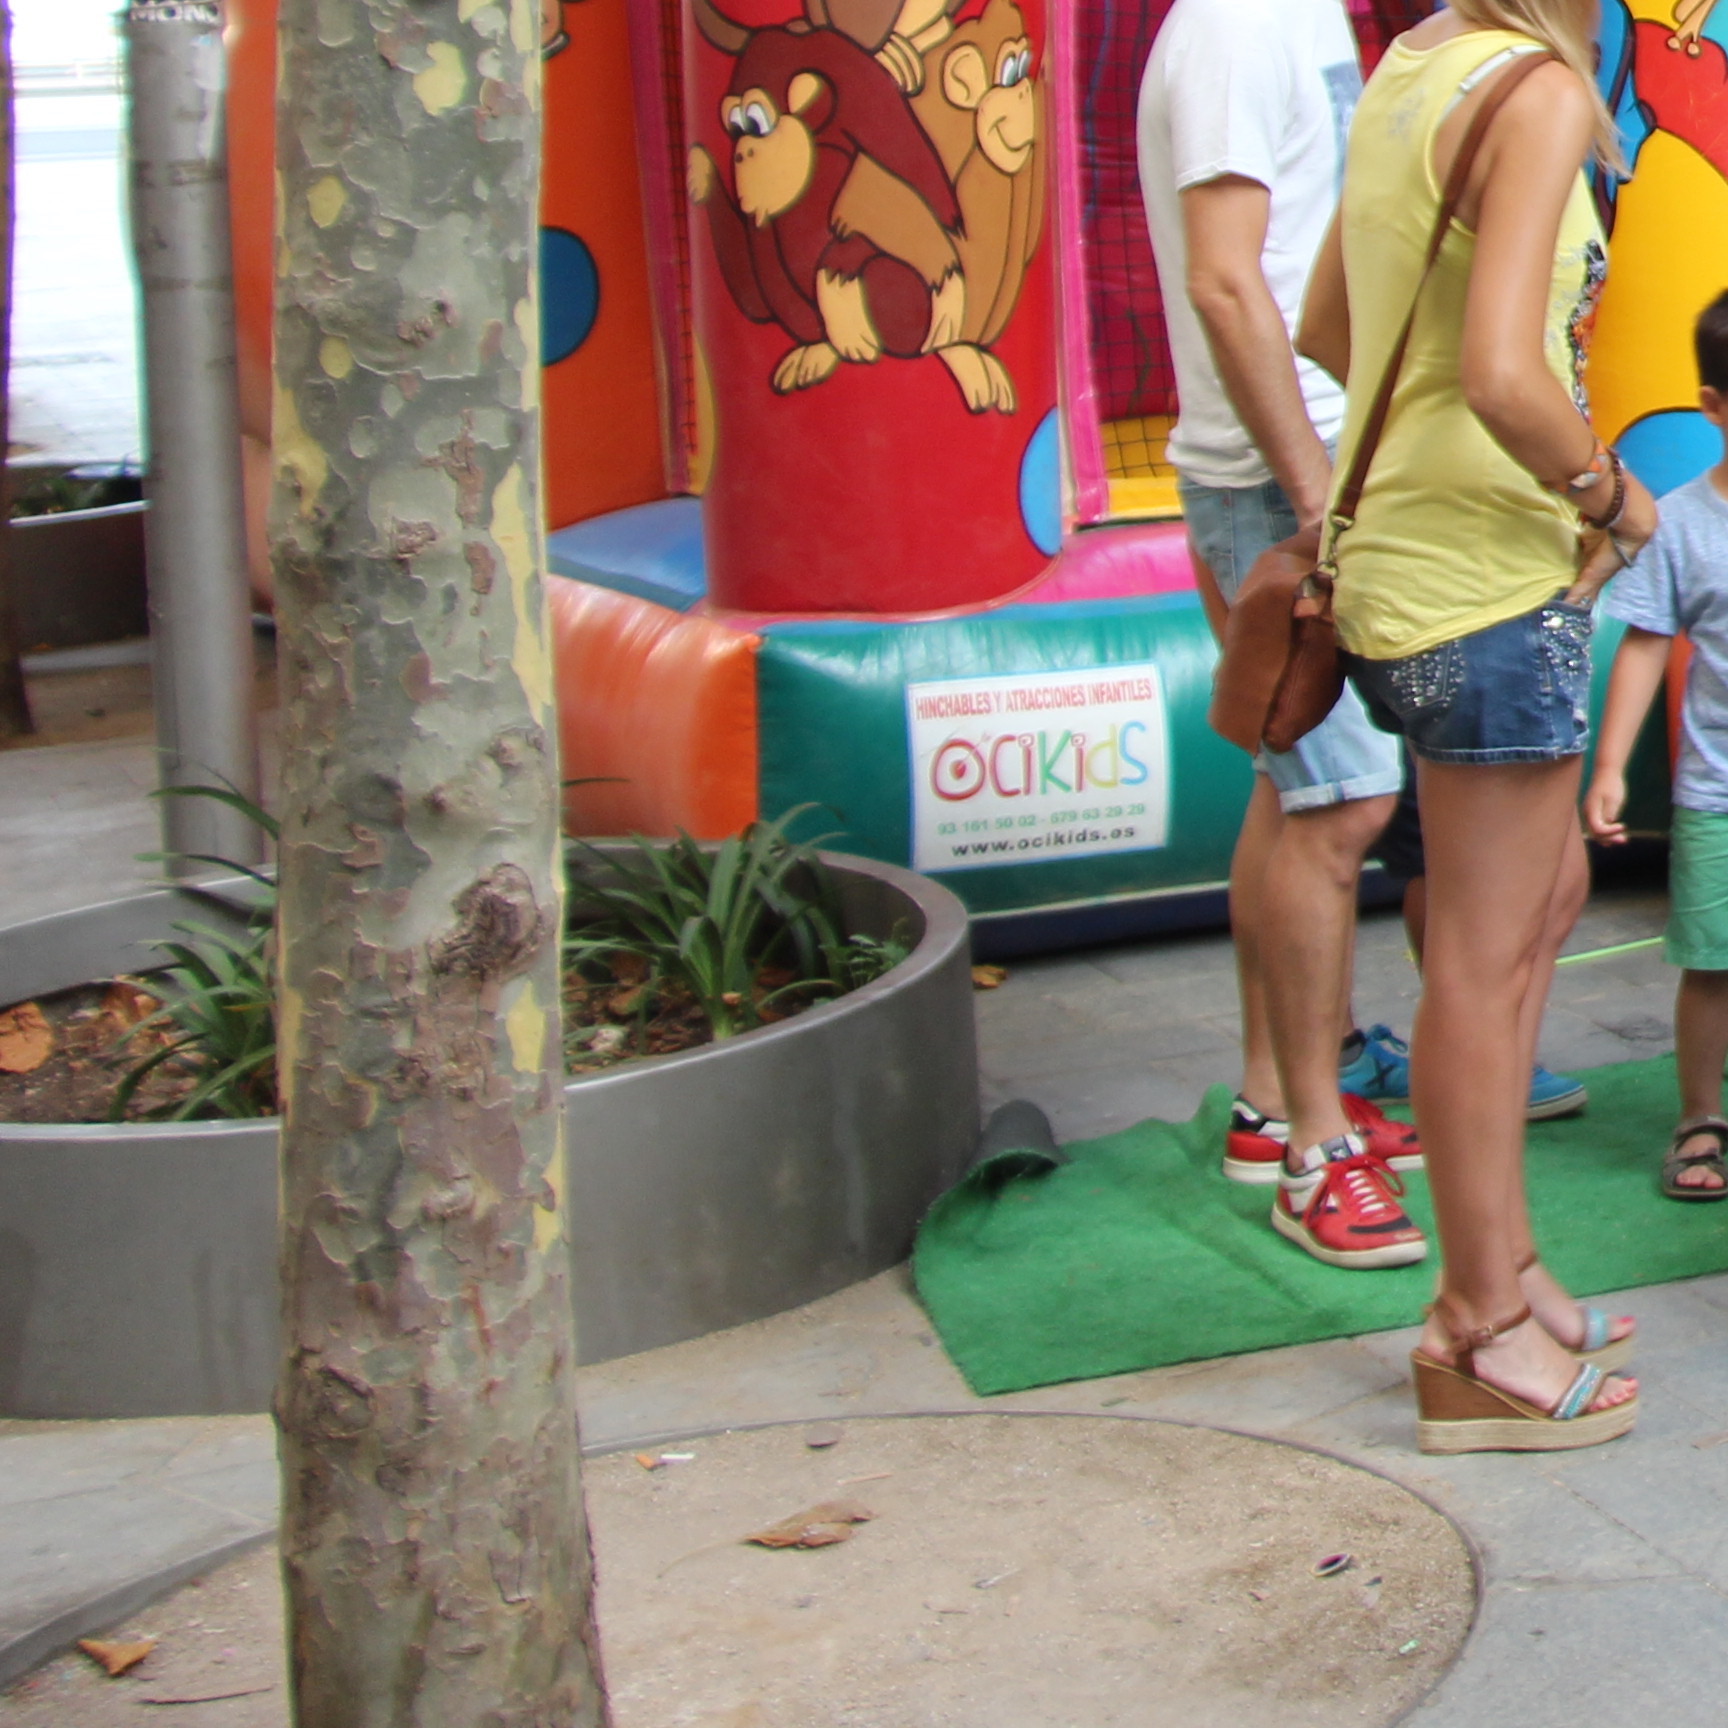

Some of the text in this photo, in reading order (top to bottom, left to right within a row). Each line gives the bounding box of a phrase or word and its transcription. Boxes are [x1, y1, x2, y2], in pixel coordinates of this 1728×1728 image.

[916, 678, 1152, 720] HINCHABLES Y ATRACCIONES INFANTILES
[952, 826, 1136, 857] www.ocikids.es
